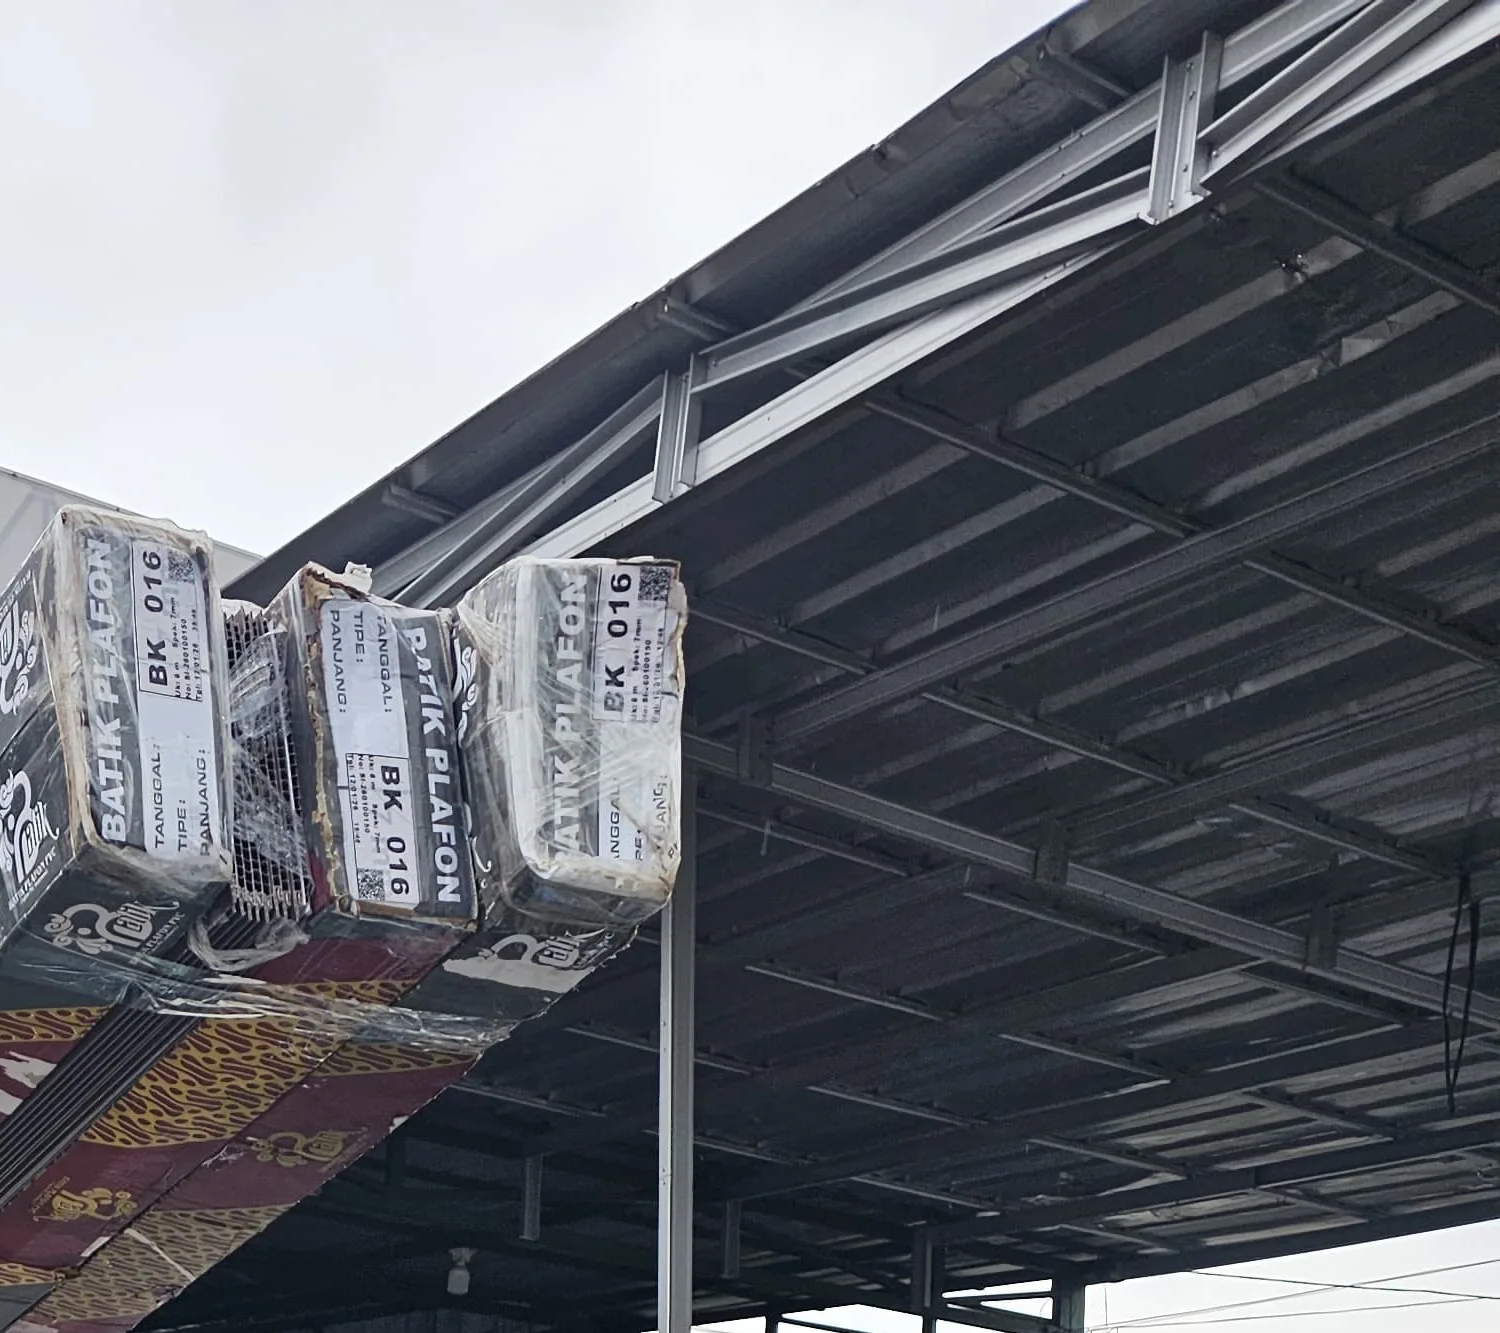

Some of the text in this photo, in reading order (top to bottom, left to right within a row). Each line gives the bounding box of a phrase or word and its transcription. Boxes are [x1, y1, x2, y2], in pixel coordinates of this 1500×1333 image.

[143, 550, 168, 686] BK 016
[330, 610, 347, 713] PANJANG:
[604, 573, 632, 712] BK 016
[87, 539, 126, 842] BATIK PLAFON
[555, 573, 588, 852] ATIK PLAFON
[381, 765, 410, 895] BK 016
[425, 748, 461, 903] PLAFON
